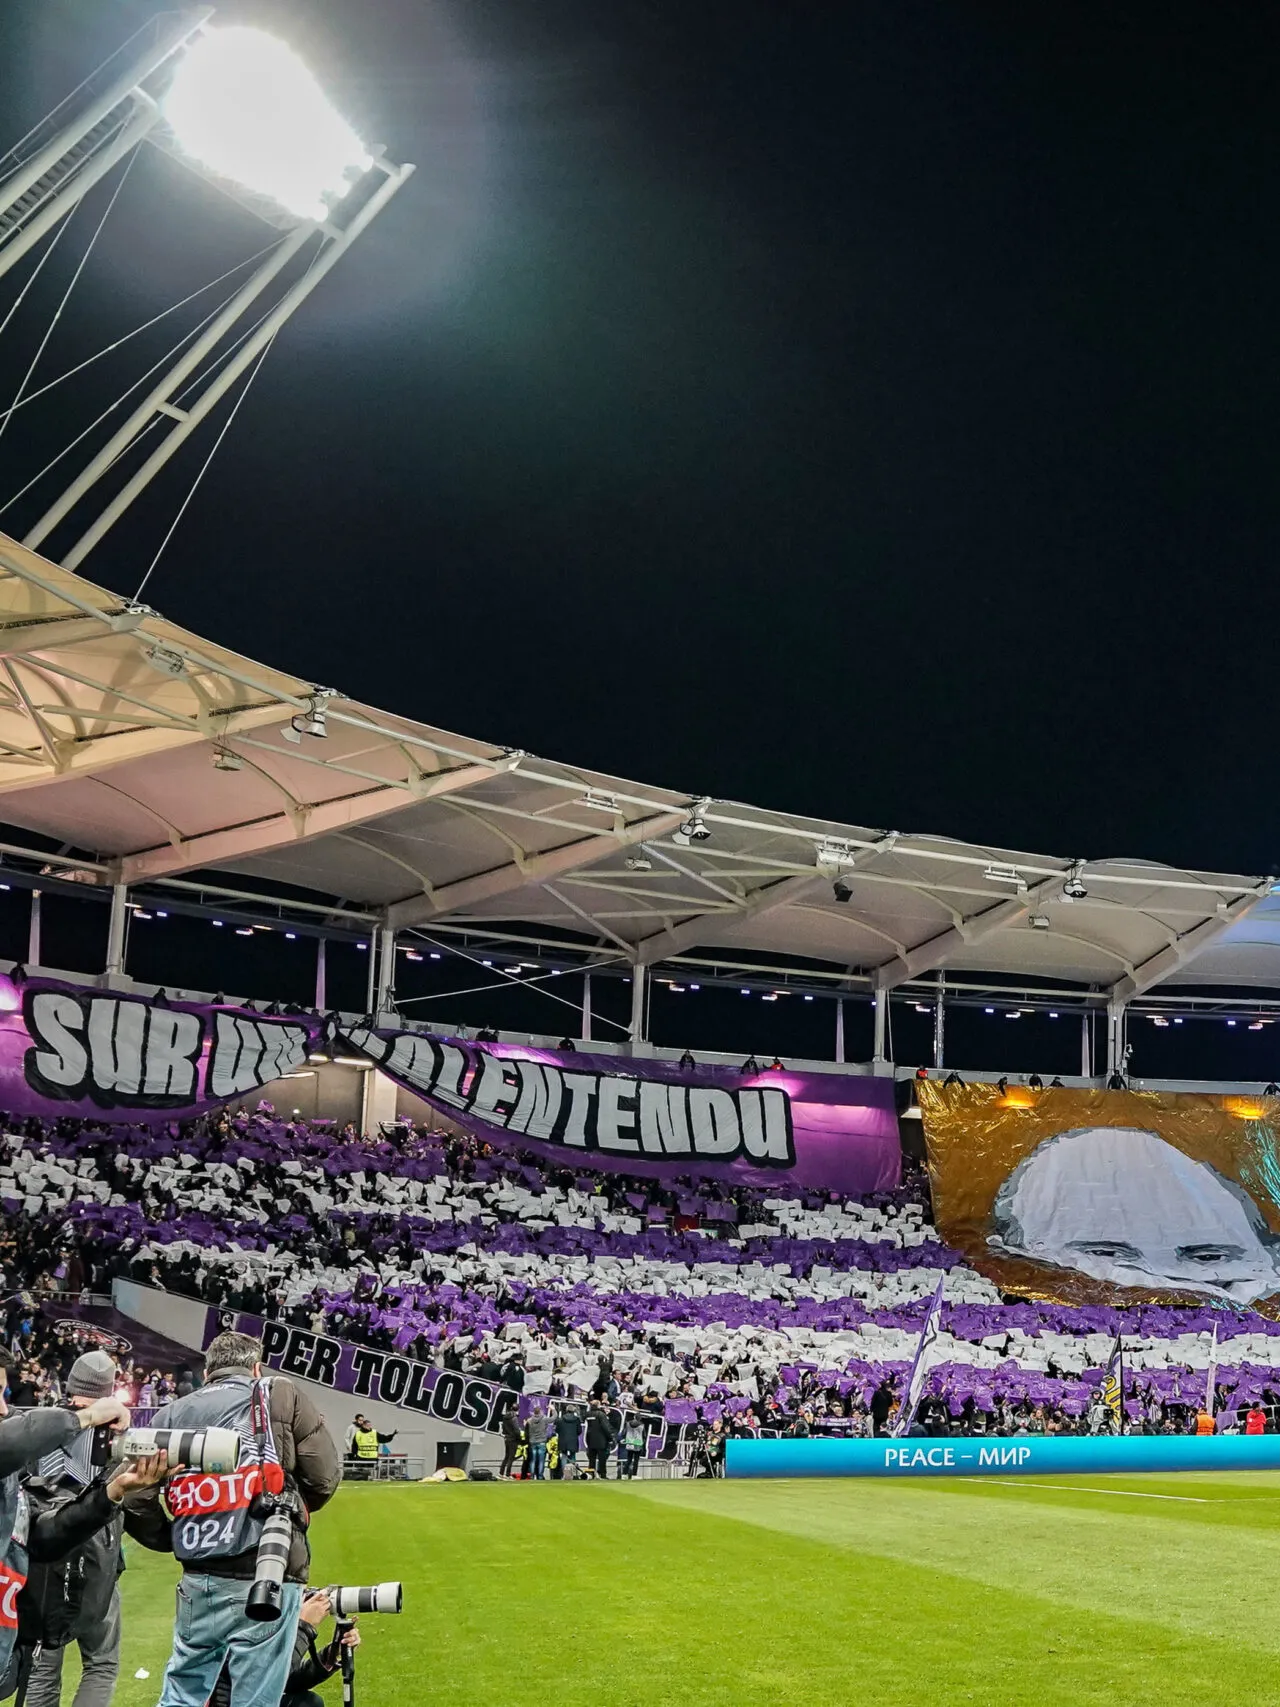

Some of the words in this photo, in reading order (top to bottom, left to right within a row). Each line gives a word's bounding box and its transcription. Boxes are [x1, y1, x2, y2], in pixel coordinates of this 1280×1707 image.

[30, 991, 201, 1099] SUR
[261, 1320, 343, 1387] PER
[351, 1347, 521, 1437] TOLOSA
[885, 1448, 956, 1467] PEACE
[979, 1446, 1031, 1466] МИР
[182, 1515, 236, 1550] 024
